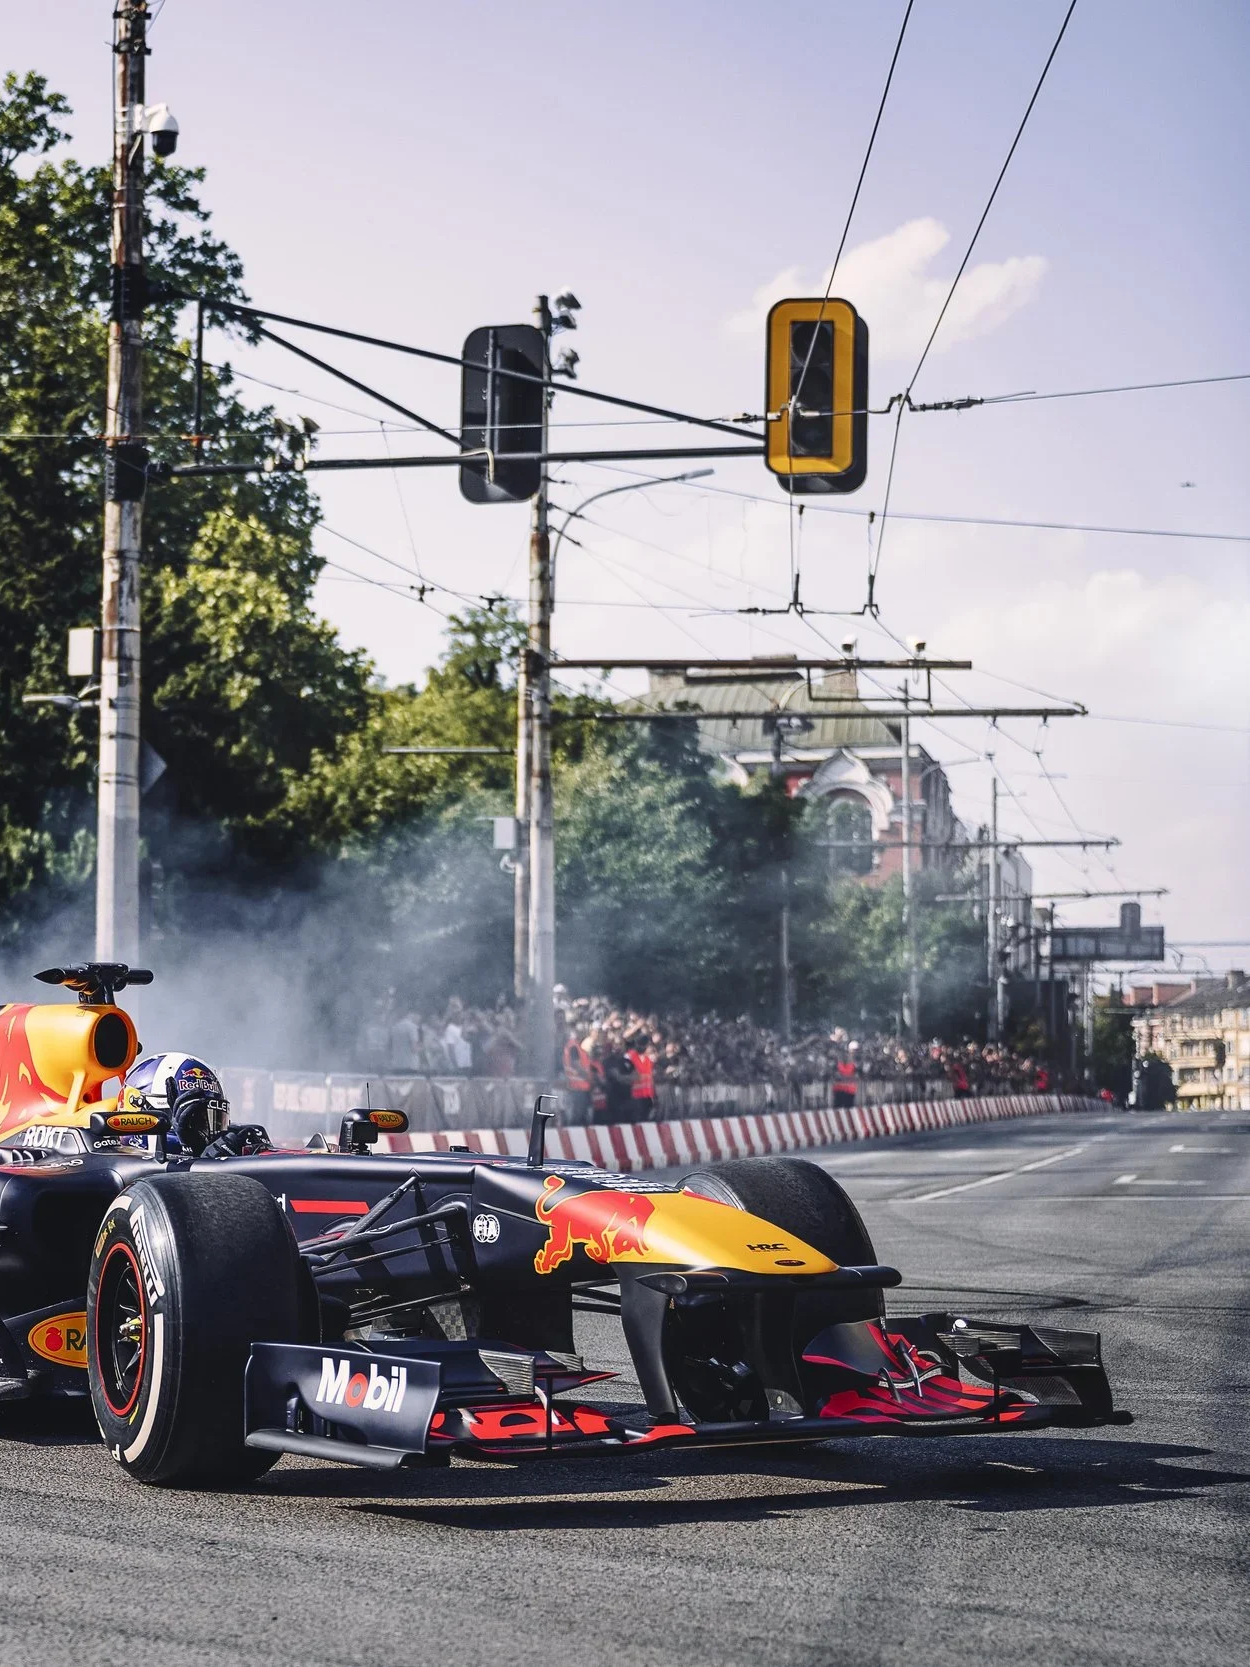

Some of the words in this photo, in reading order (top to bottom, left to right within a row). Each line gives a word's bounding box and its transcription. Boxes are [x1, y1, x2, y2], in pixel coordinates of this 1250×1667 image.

[179, 1080, 201, 1091] Red
[208, 1099, 227, 1112] CLE
[120, 1117, 152, 1126] RAUCH
[22, 1125, 69, 1149] ROKT
[129, 1204, 166, 1307] PIRELLI
[316, 1357, 407, 1413] Mobil
